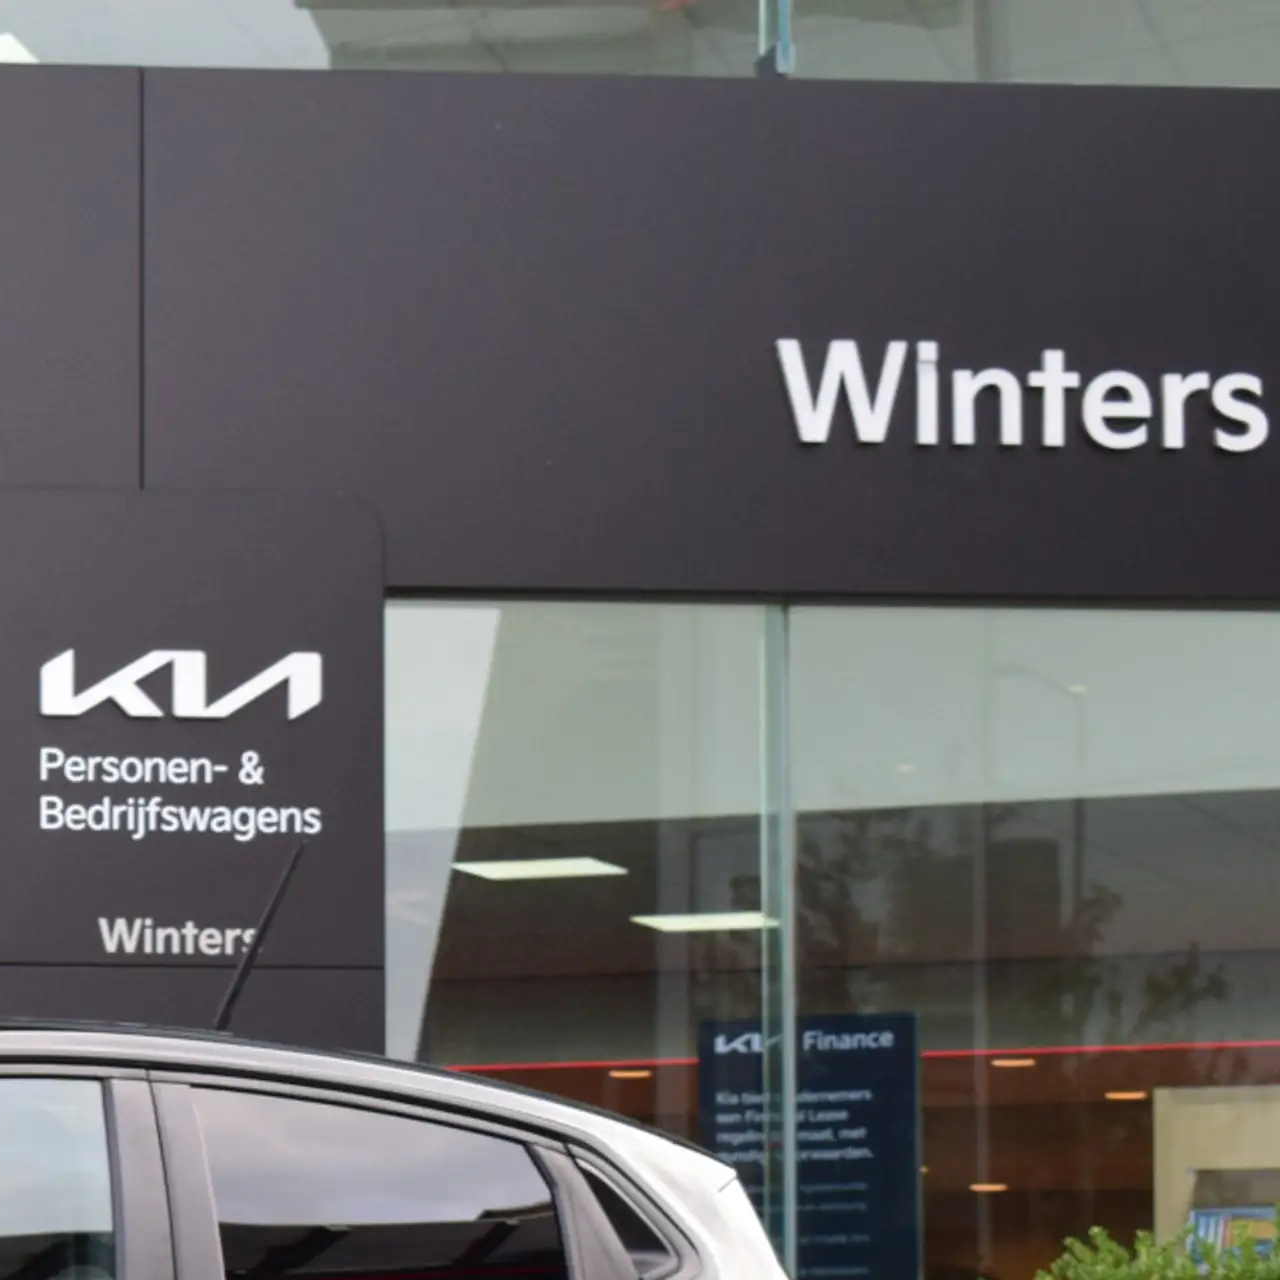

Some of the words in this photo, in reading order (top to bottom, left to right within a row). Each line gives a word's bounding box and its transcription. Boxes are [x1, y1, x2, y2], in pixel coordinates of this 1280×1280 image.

[776, 337, 1269, 453] Winters
[40, 648, 322, 720] KIA
[40, 747, 228, 785] Personen-
[238, 750, 266, 786] &
[40, 796, 322, 842] Bedrijfswagens
[802, 1029, 896, 1052] Finance
